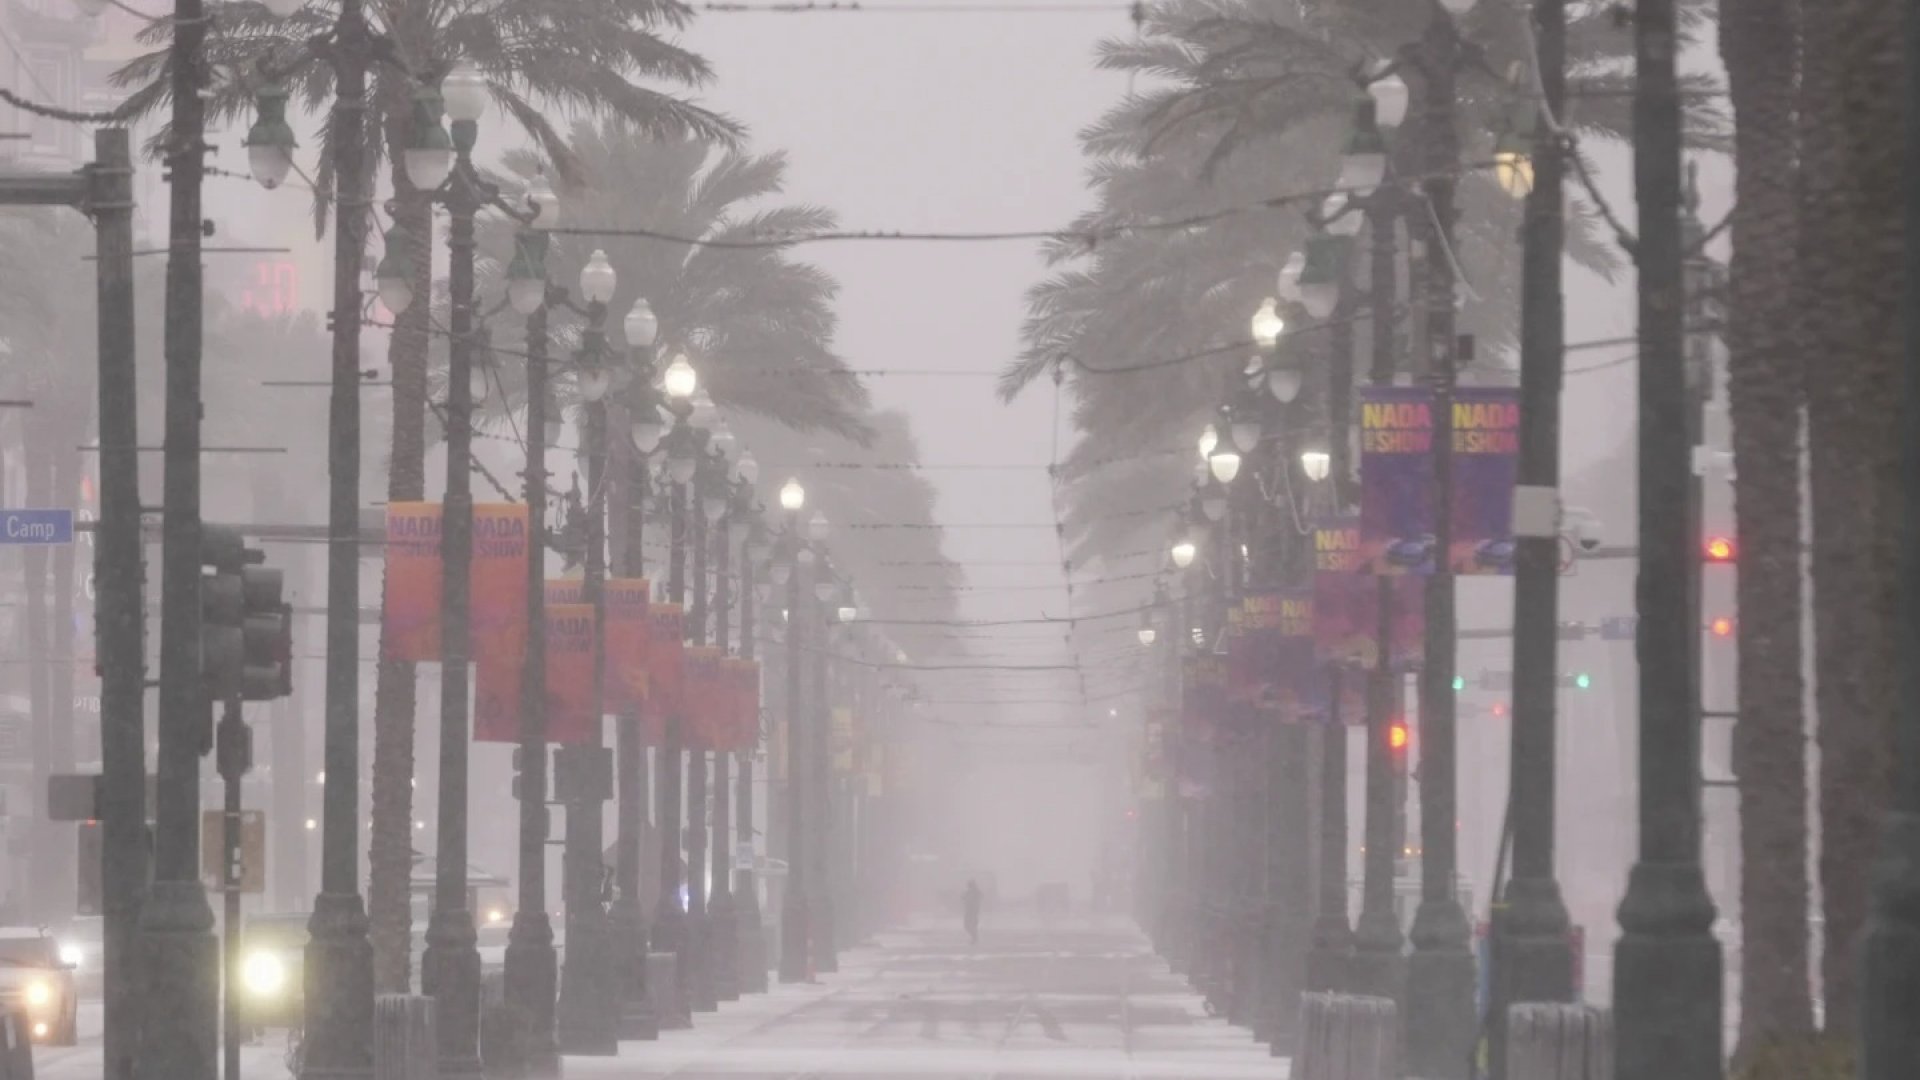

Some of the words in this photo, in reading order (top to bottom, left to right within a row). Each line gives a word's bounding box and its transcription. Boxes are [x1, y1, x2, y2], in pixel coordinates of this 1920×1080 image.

[1363, 403, 1432, 429] NADA
[1452, 403, 1519, 429] NADA
[6, 515, 55, 541] Camp
[1316, 529, 1360, 550] NAD
